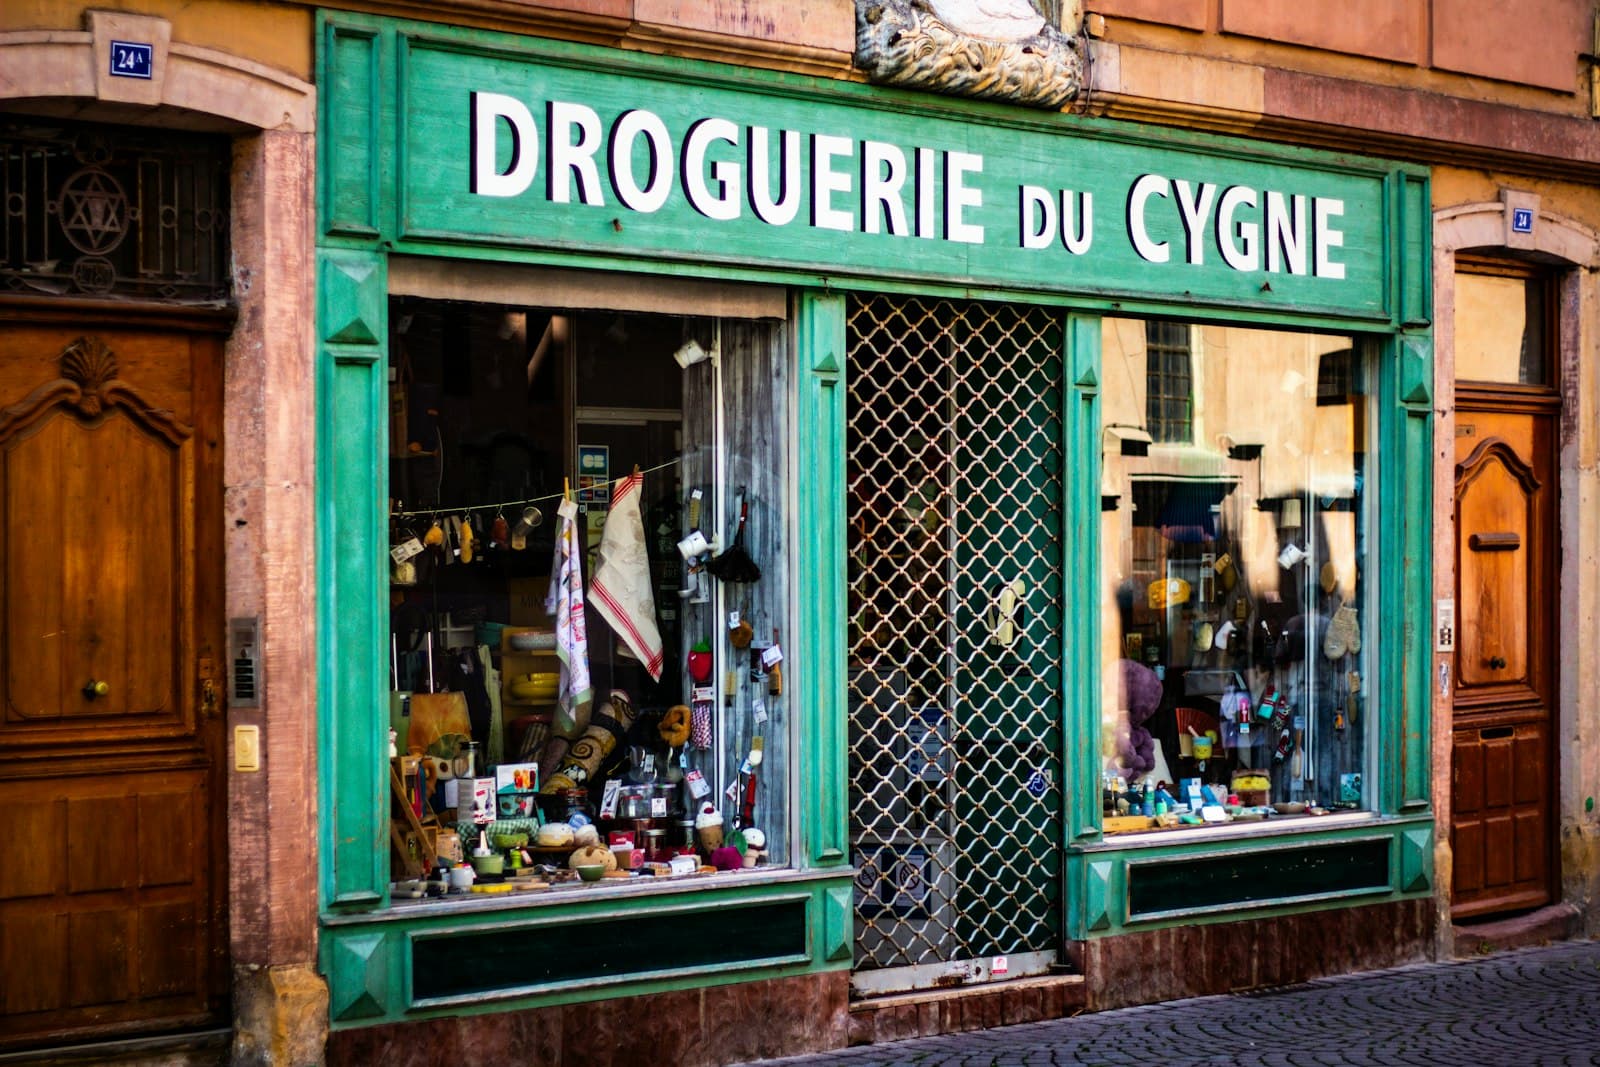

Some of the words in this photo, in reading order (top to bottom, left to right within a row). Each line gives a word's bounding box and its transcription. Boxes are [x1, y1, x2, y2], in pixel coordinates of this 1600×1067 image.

[470, 91, 984, 243] DROGUERIE
[1019, 184, 1093, 256] DU
[1126, 174, 1345, 280] CYGNE
[1518, 213, 1528, 227] 24
